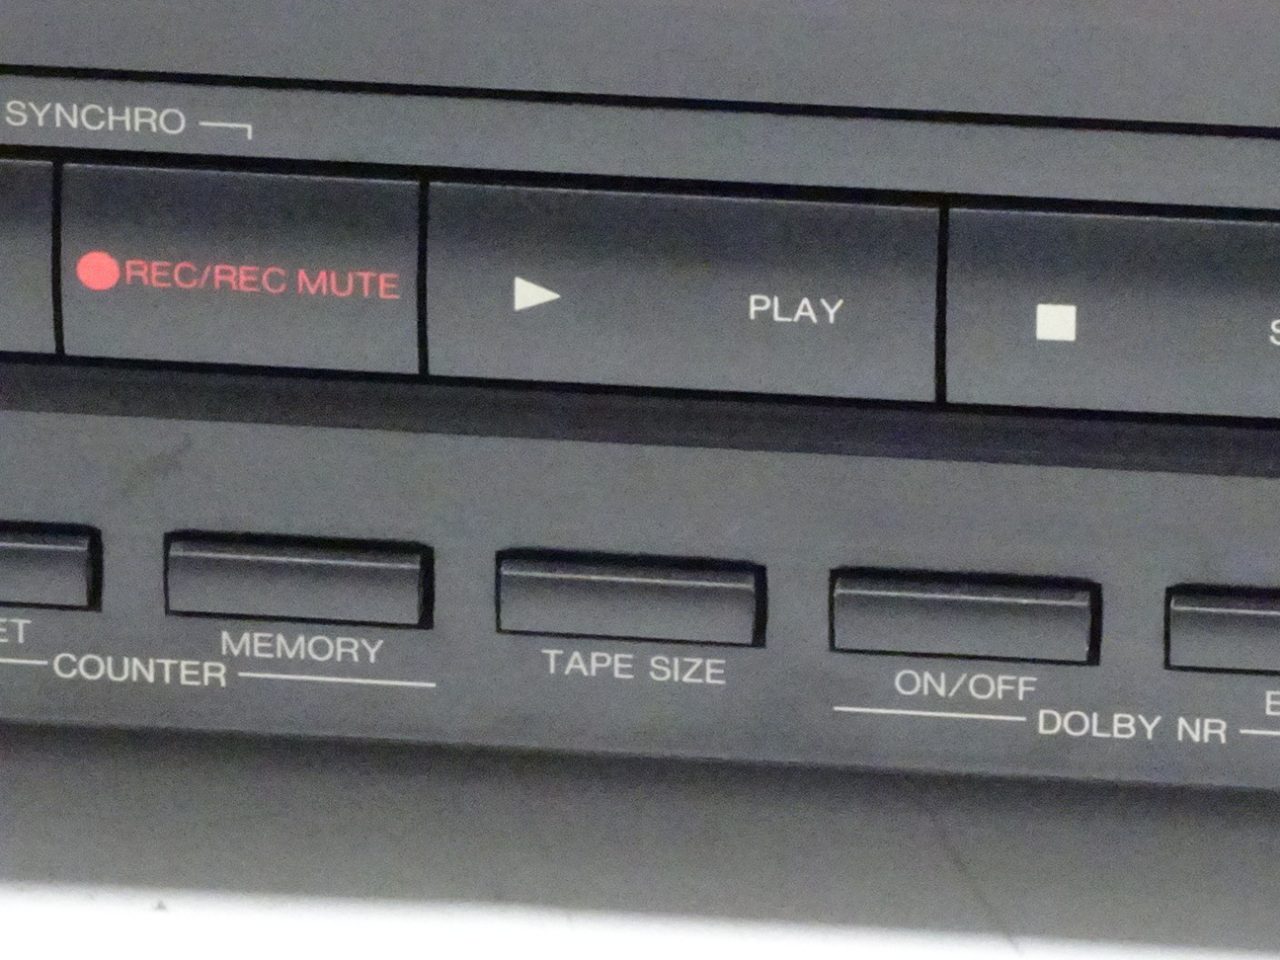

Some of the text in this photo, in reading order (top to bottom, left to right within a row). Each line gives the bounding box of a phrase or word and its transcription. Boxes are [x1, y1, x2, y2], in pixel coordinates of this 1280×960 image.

[5, 100, 186, 135] SYNCHRO
[124, 259, 399, 299] REC/REC MUTE
[749, 294, 844, 324] PLAY
[219, 630, 385, 664] MEMORY
[53, 653, 228, 687] COUNTER
[541, 649, 726, 685] TAPE SIZE
[894, 669, 1038, 701] ON/OFF
[1038, 709, 1227, 744] DOLBY NR
